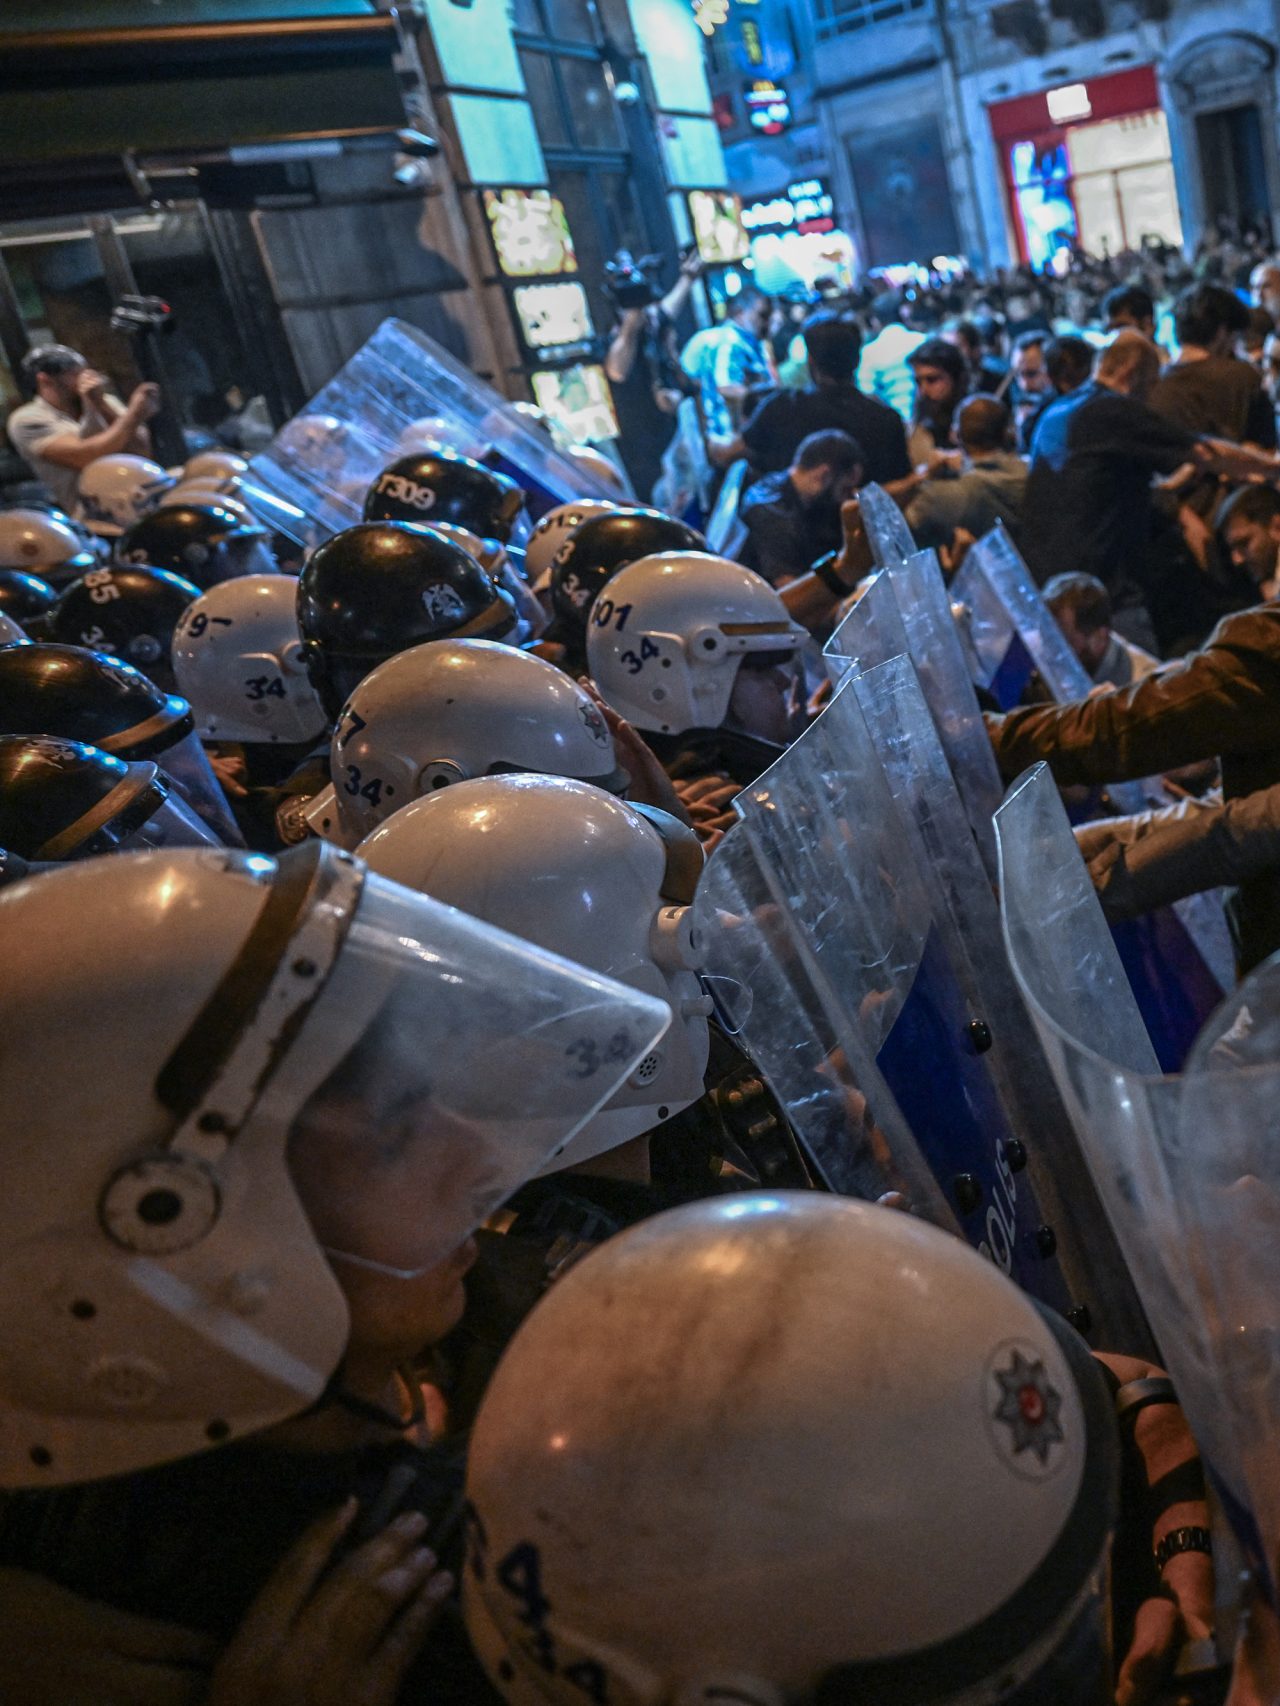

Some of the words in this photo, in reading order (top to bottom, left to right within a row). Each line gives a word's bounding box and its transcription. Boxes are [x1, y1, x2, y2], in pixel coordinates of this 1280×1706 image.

[84, 566, 120, 604] 85
[621, 636, 660, 674] 34
[245, 676, 286, 699] 34
[344, 765, 382, 807] 34
